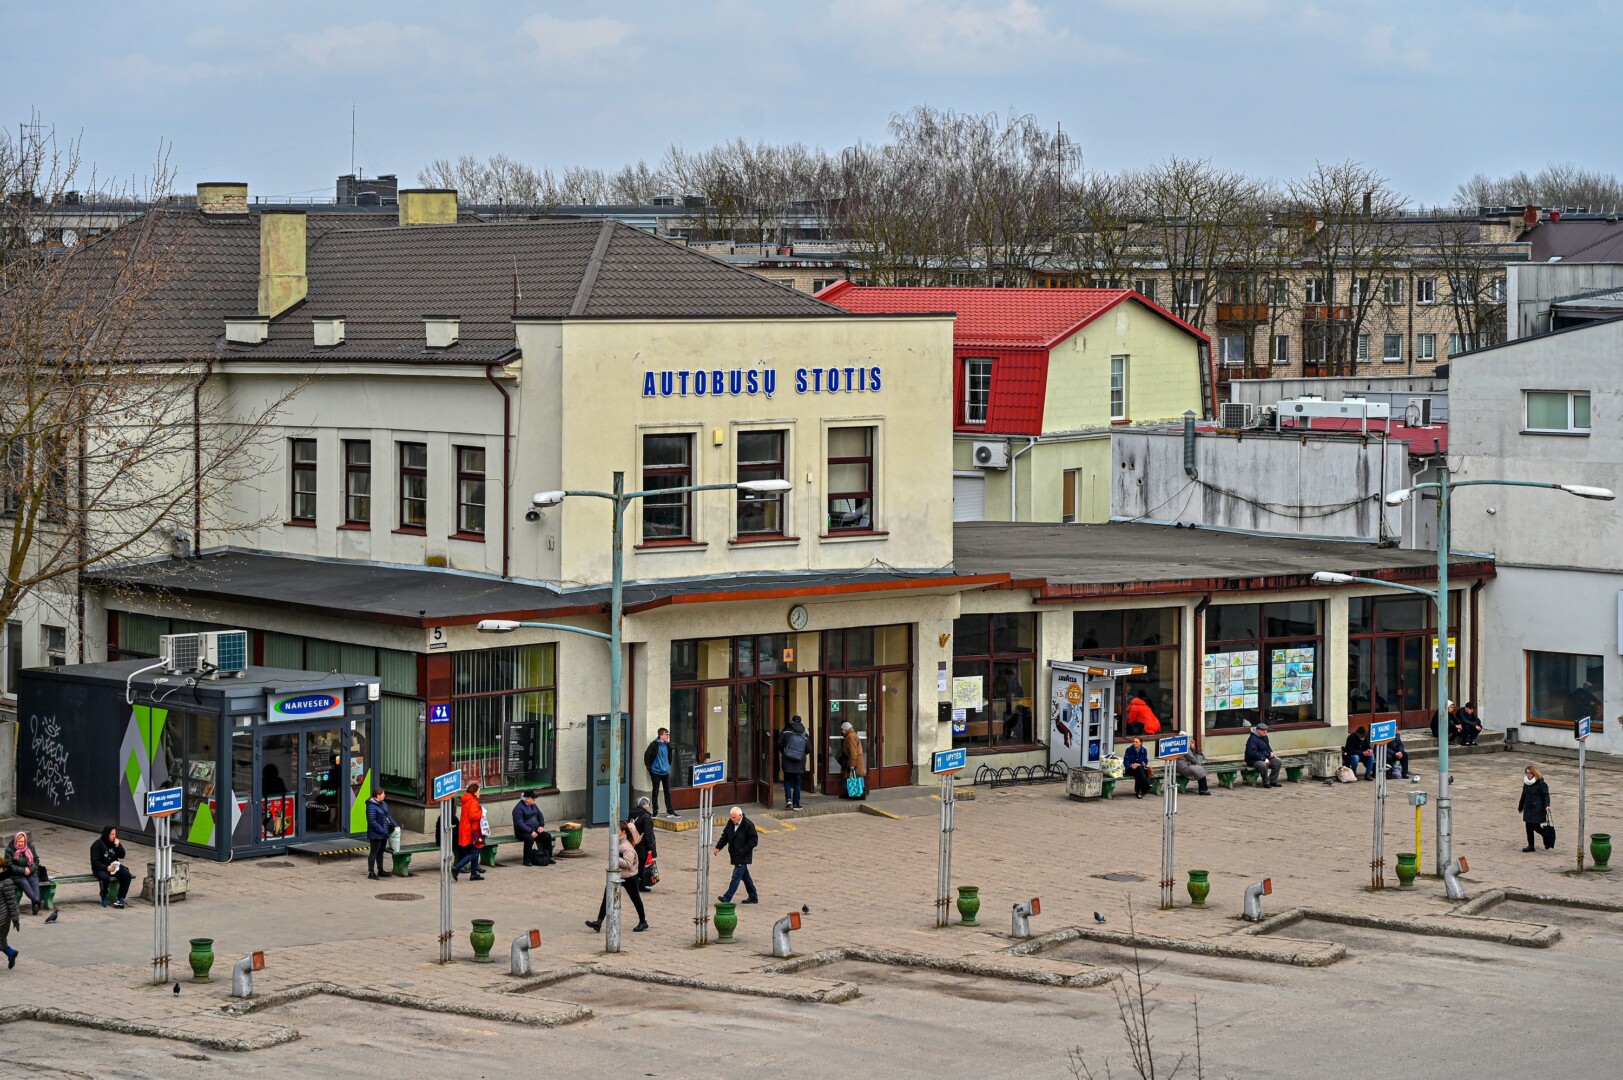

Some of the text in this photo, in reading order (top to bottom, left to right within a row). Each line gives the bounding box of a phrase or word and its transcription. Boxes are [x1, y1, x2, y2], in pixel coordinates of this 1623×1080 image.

[643, 366, 881, 399] AUTOBUSŲ STOTIS
[434, 627, 442, 640] 5
[1058, 675, 1077, 683] LAVAZZA
[285, 699, 329, 710] NARVESEN
[1165, 739, 1187, 747] RAMYGALOS
[937, 751, 962, 768] 11 UPYTĖS
[443, 774, 458, 786] ŠIAULIŲ
[694, 768, 701, 781] 12
[148, 795, 156, 808] 14
